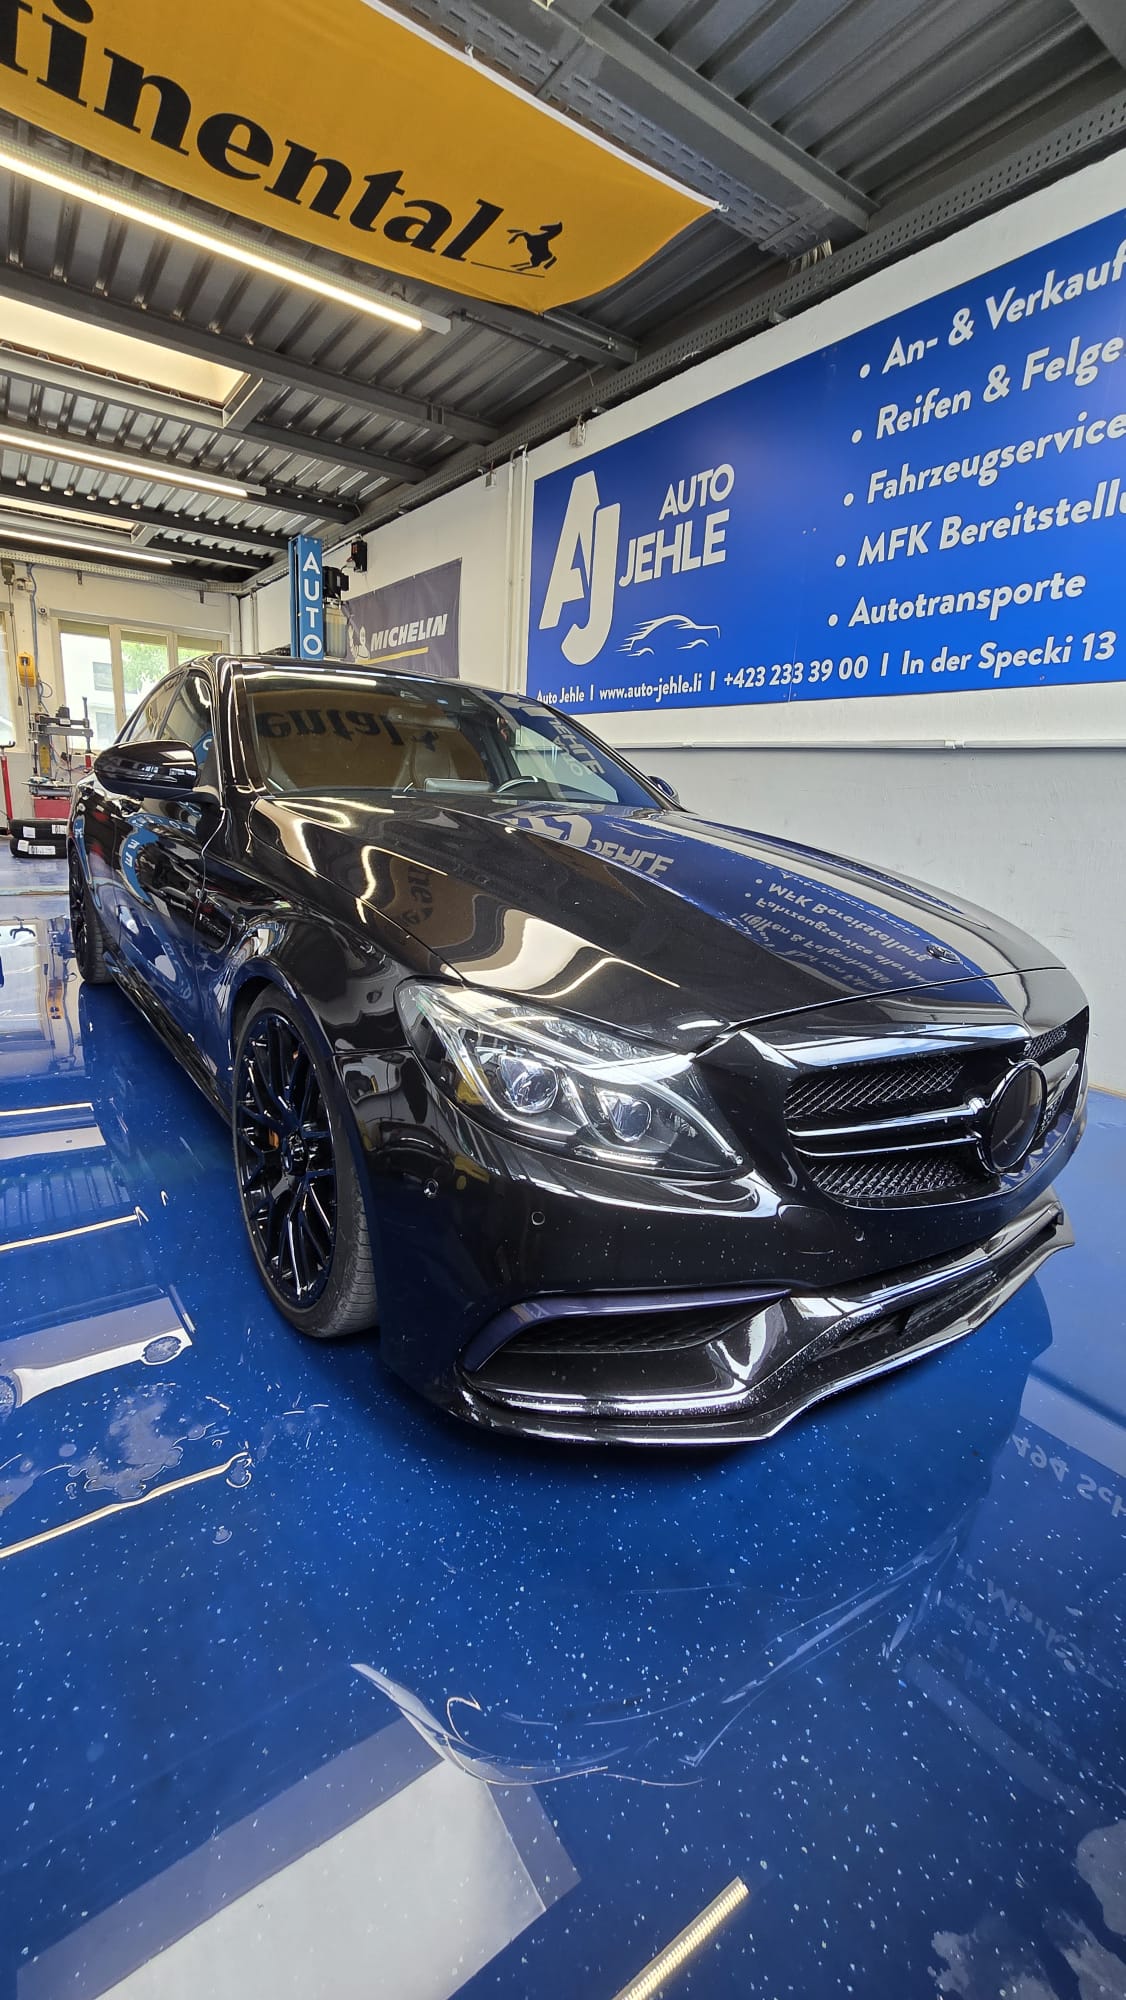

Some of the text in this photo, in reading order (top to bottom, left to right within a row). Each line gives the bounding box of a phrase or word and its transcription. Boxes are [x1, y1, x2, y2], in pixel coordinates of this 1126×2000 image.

[881, 239, 1126, 374] An- & Verkauf
[876, 335, 1126, 441] Reifen & Felge
[658, 463, 735, 520] AUTO
[867, 411, 1126, 504] Fahrzeugservice
[618, 508, 730, 588] JEHLE
[857, 520, 932, 567] MFK
[302, 551, 323, 655] AUTO
[370, 613, 449, 652] MICHELIN
[848, 571, 1087, 628] Autotransporte
[537, 690, 558, 704] Auto
[559, 686, 585, 703] Jehle
[600, 673, 703, 703] www.auto-jehle.li
[724, 666, 766, 688] +423
[769, 662, 804, 686] 233
[808, 658, 834, 683] 39
[838, 655, 869, 680] 00
[901, 650, 924, 675] In
[931, 646, 972, 673] der
[977, 635, 1074, 678] Specki
[1081, 630, 1117, 662] 13
